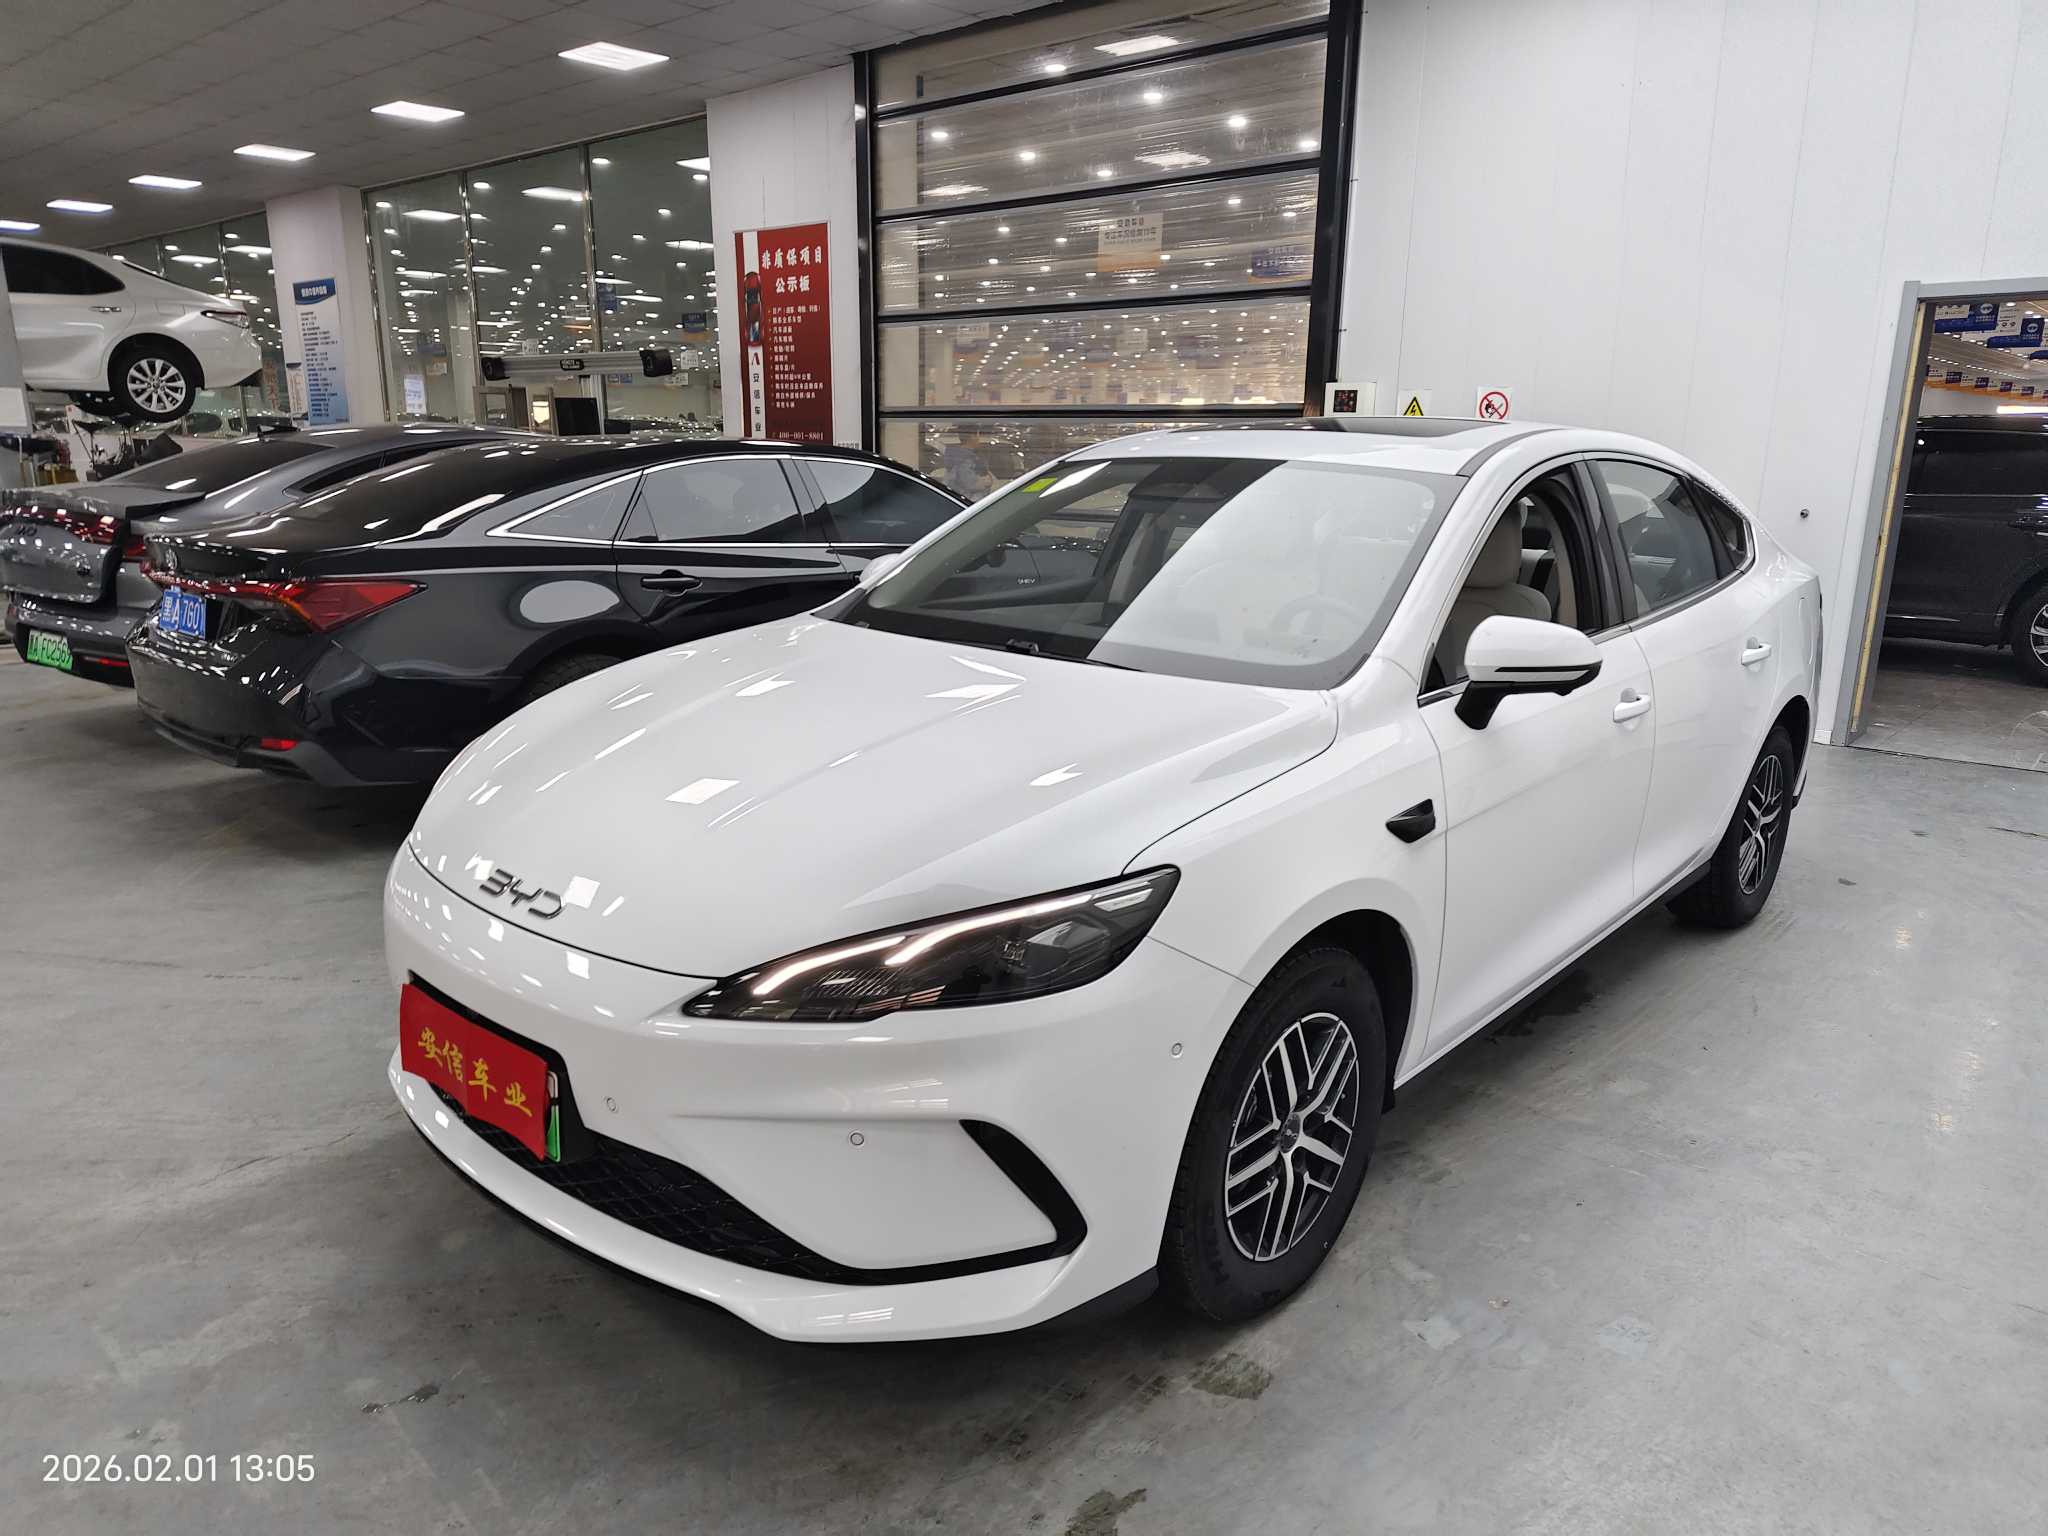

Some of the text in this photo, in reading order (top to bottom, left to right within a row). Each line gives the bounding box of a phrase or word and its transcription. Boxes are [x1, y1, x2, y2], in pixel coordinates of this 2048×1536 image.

[761, 246, 823, 270] 非质保项目
[775, 274, 811, 294] 公示板
[752, 372, 762, 432] 安信车业
[479, 868, 565, 919] BYD
[417, 1026, 533, 1118] 安信车业
